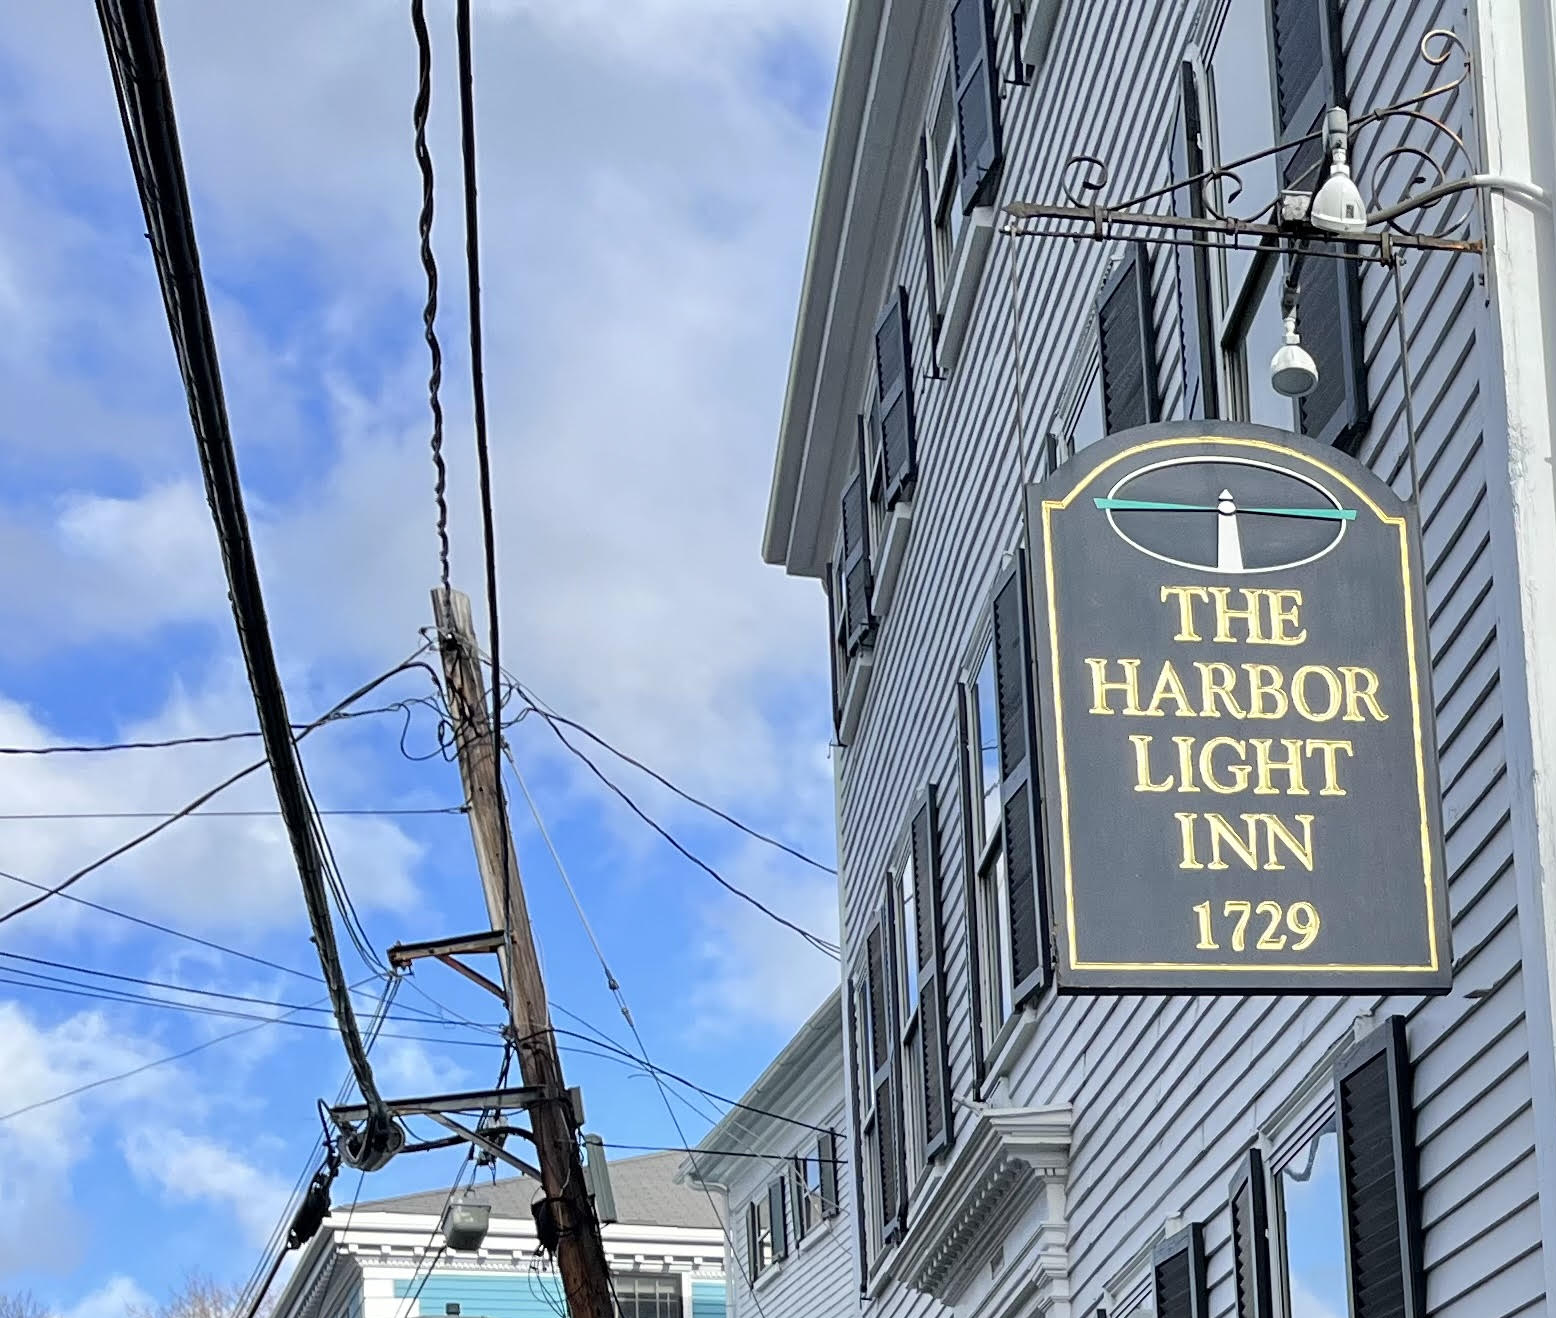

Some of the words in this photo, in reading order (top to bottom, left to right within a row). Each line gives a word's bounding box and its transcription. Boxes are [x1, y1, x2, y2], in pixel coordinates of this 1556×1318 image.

[1160, 585, 1307, 646] THE
[1084, 657, 1390, 723] HARBOR
[1128, 734, 1353, 796] LIGHT
[1174, 811, 1315, 871] INN
[1193, 899, 1321, 951] 1729
